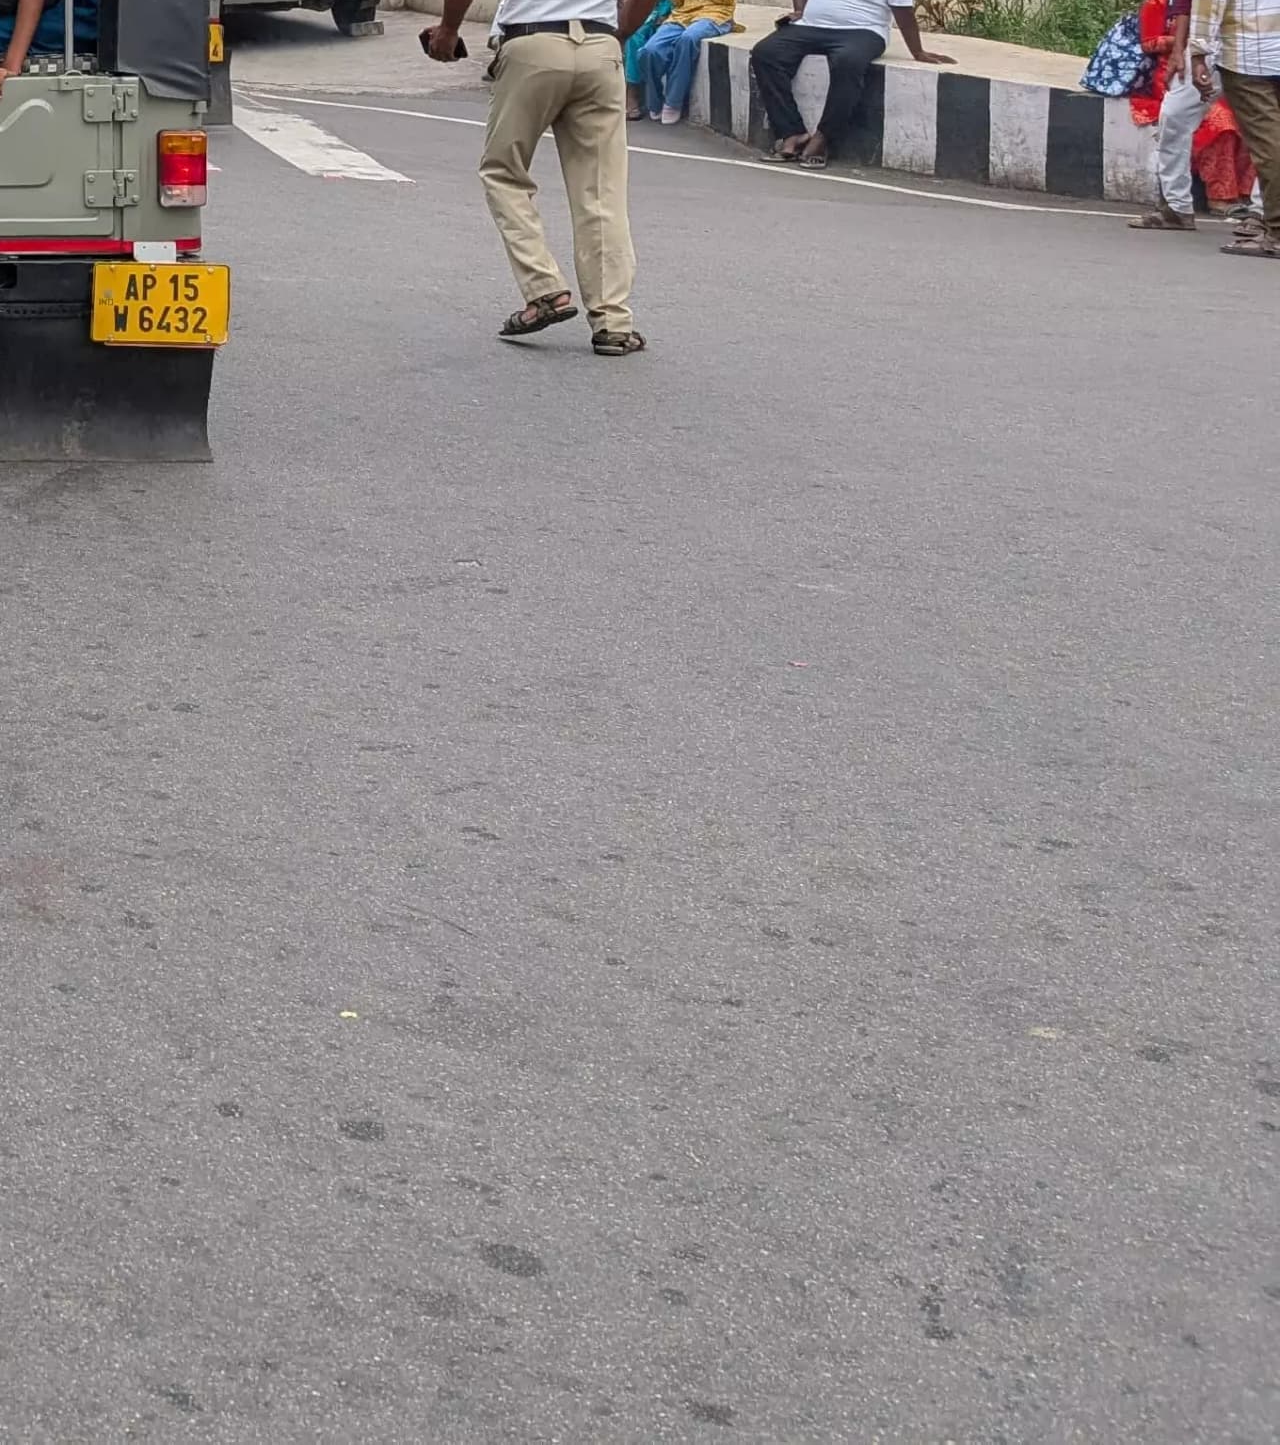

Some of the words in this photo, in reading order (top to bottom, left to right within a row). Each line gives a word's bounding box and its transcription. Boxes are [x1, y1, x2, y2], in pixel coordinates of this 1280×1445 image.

[124, 274, 157, 301] AP
[169, 274, 199, 302] 15
[138, 306, 208, 334] 6432
